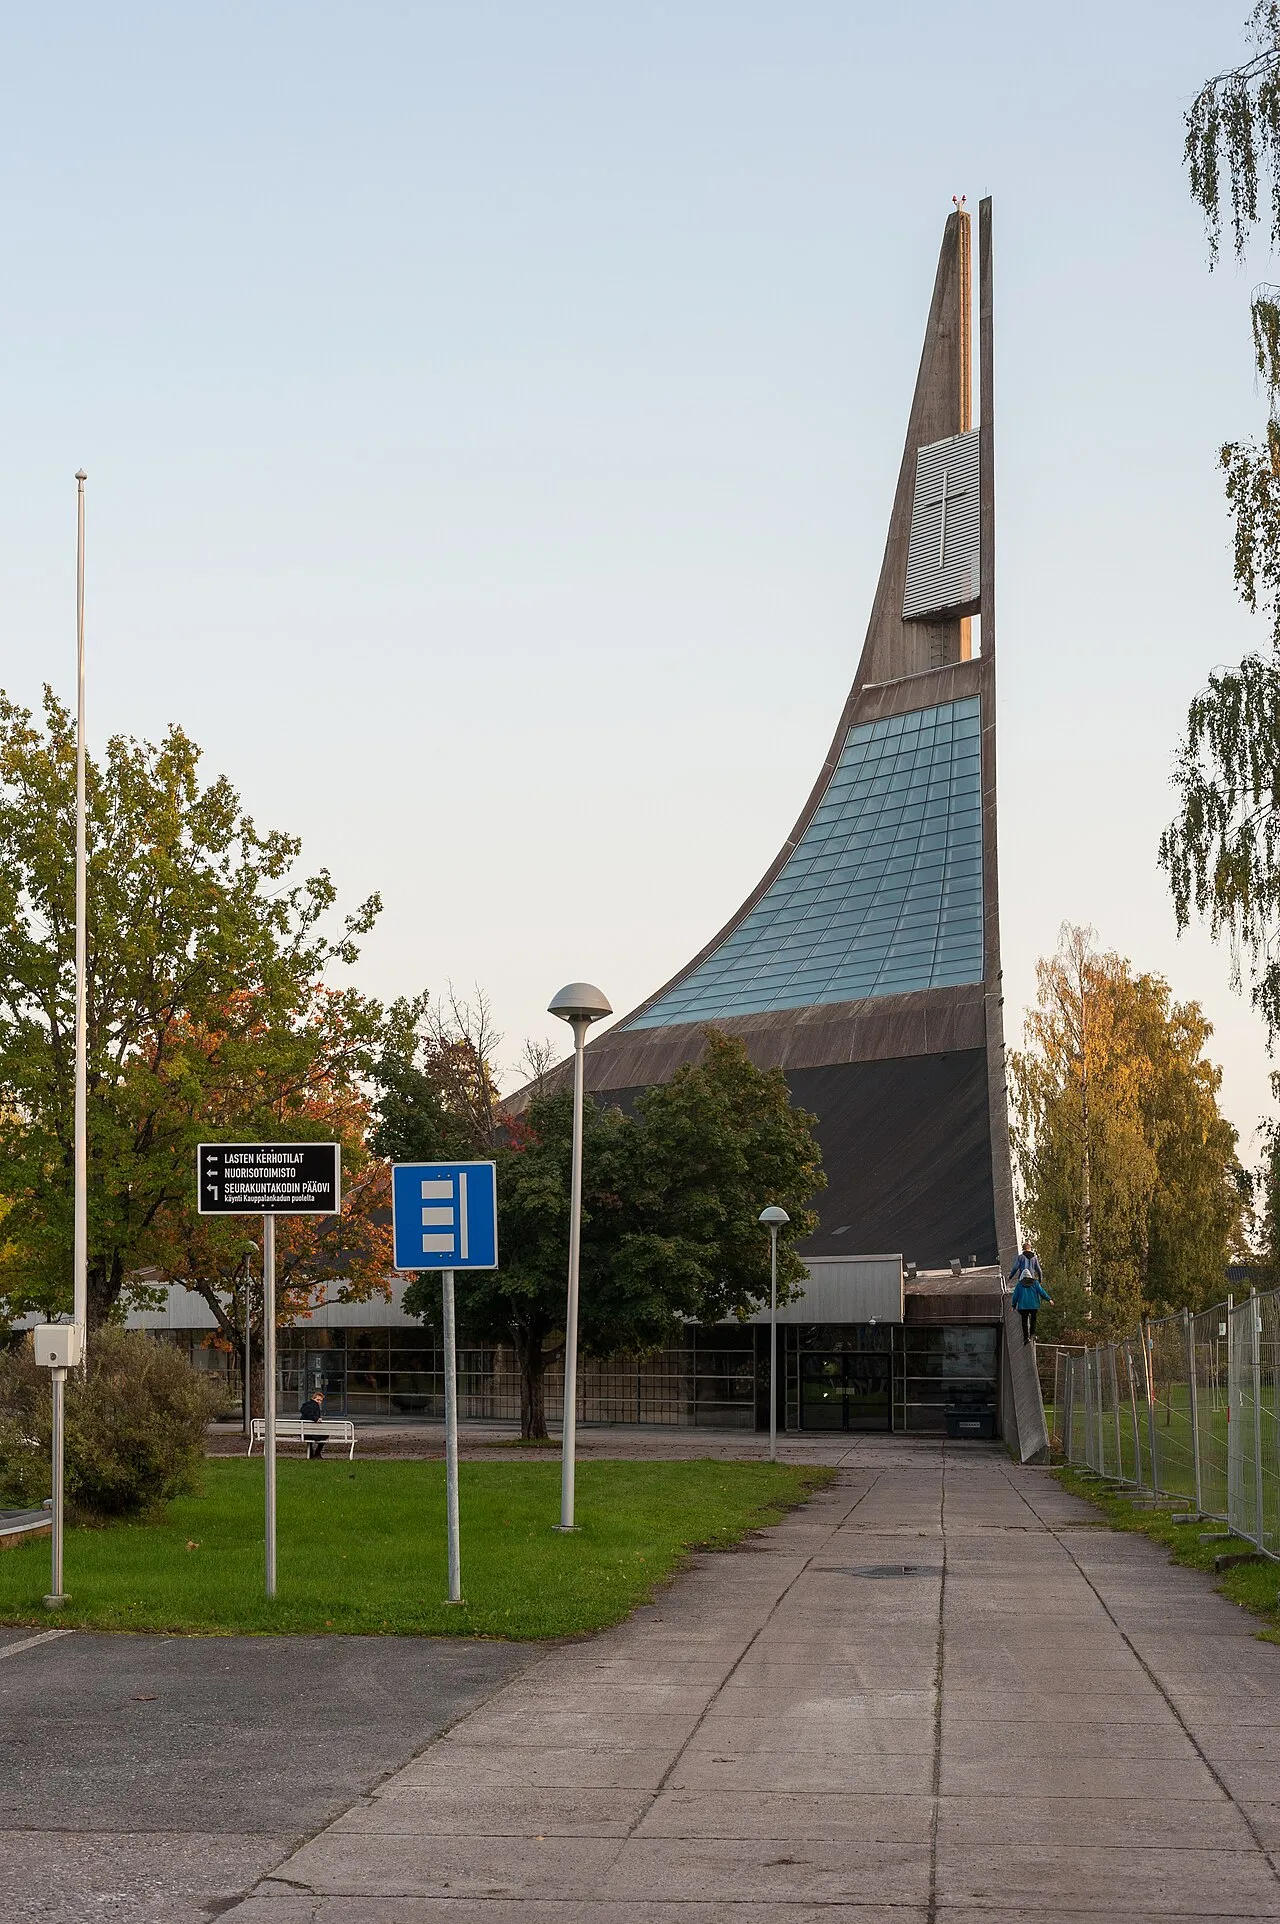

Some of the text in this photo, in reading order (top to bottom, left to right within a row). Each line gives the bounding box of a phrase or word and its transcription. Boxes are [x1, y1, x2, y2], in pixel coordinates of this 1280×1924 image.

[224, 1153, 304, 1164] LASTEN KERHOTILAT
[224, 1167, 296, 1178] NUORISOTOIMISTO
[224, 1181, 330, 1193] SEURAKUNTAKODIN PÄÄOVI
[224, 1194, 243, 1204] käynti
[243, 1194, 291, 1204] Kauppalankadun
